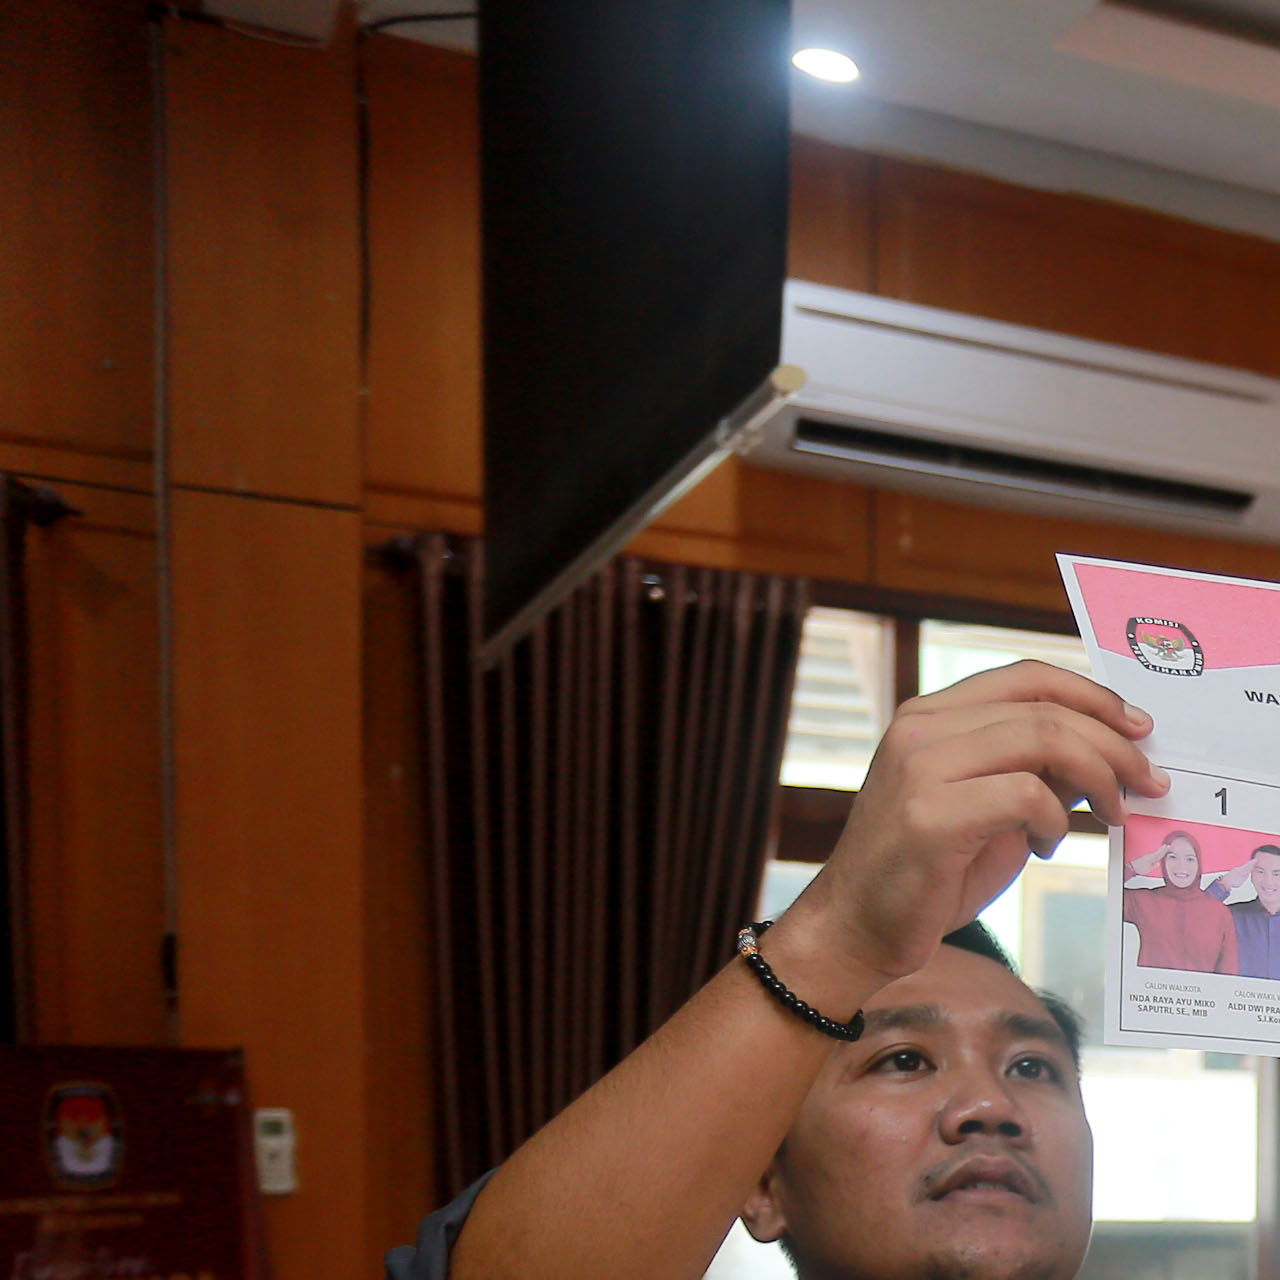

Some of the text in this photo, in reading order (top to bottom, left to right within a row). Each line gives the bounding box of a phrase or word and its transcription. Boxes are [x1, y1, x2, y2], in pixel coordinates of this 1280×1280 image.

[1136, 617, 1179, 628] KOMISI
[1214, 788, 1230, 816] 1
[1144, 982, 1201, 994] CALON WALIKOTA
[1234, 990, 1256, 999] CALON
[1129, 994, 1215, 1008] INDA RAYA AYU MIKO
[1138, 1004, 1174, 1015] SAPUTRI,
[1193, 1009, 1208, 1017] MIB
[1228, 1003, 1246, 1012] ALDI
[1248, 1005, 1264, 1013] DWI
